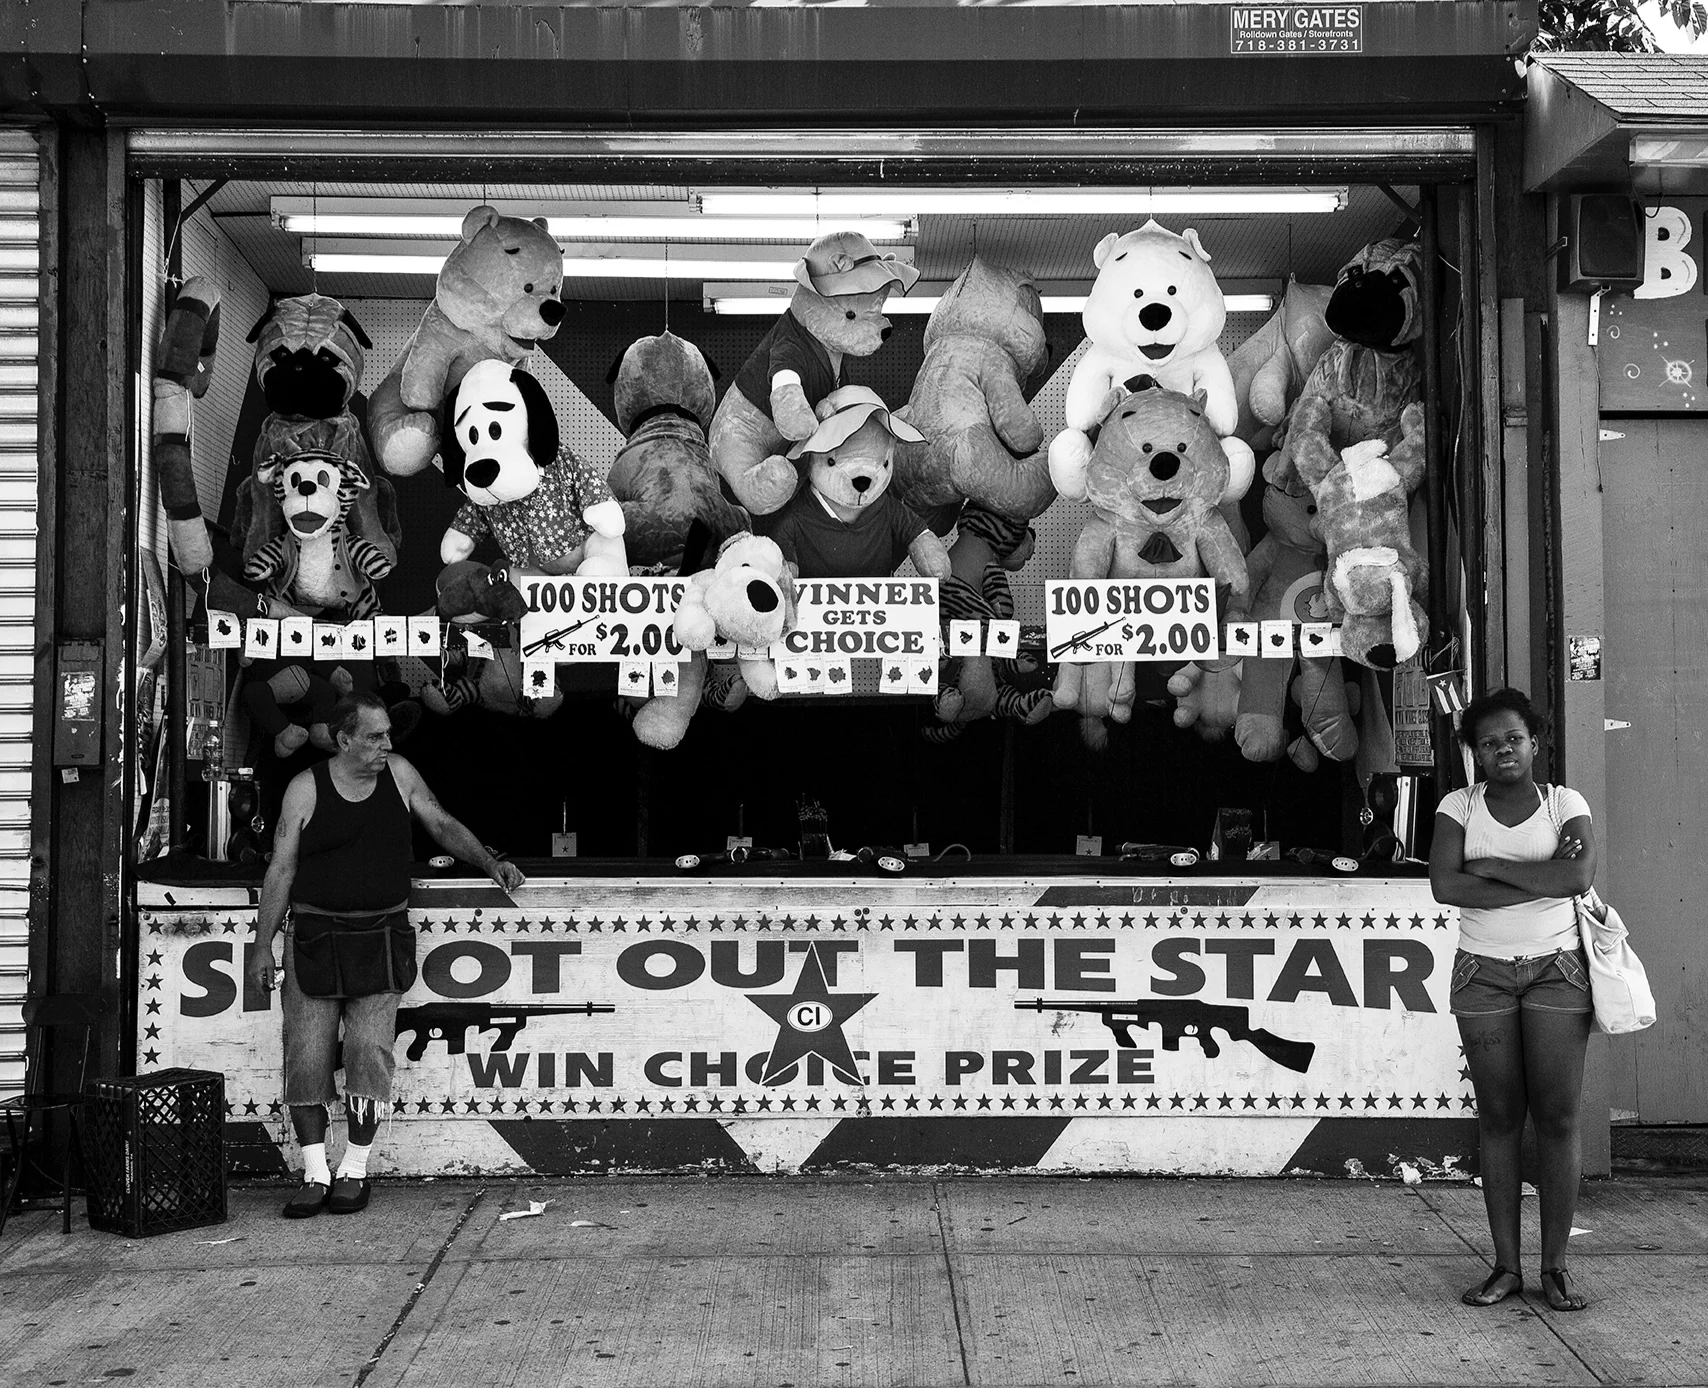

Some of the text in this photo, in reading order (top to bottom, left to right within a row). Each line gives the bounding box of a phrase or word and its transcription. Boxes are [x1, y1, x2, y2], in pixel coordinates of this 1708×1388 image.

[1233, 9, 1361, 29] MERY GATES
[1235, 39, 1359, 51] 718-381-3731
[1239, 29, 1277, 39] Rolldown
[1278, 29, 1302, 38] Gates
[1308, 29, 1354, 38] Storefronts
[527, 582, 685, 614] 100 SHOTS
[1051, 584, 1210, 616] 100 SHOTS
[822, 610, 887, 626] GETS
[568, 622, 684, 657] FOR $2.00
[785, 630, 925, 654] CHOICE
[1095, 622, 1211, 657] FOR $2.00
[179, 937, 1437, 1018] SOT OUT THE STAR
[797, 1006, 821, 1026] CI
[466, 1051, 614, 1089] WIN
[945, 1050, 1155, 1086] PRIZE
